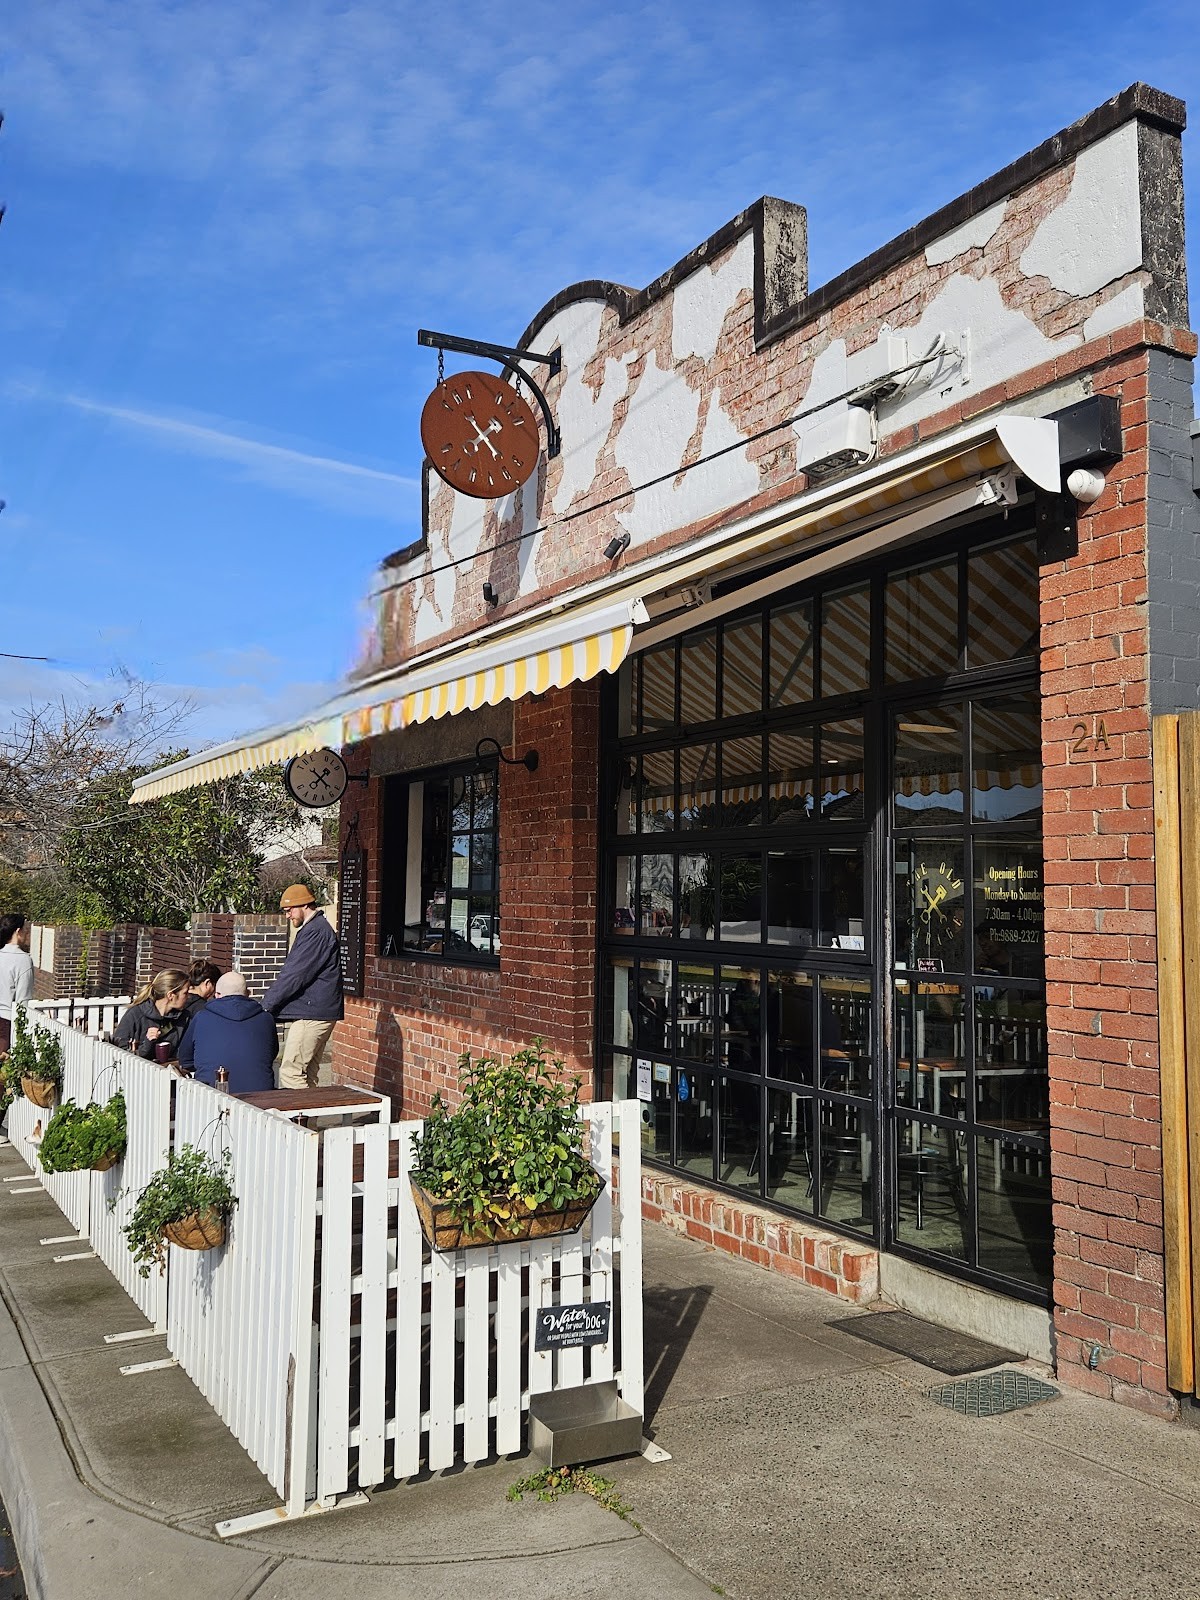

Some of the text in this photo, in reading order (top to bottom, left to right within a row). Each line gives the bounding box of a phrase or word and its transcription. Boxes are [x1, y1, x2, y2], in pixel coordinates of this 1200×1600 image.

[495, 391, 525, 426] OLD
[441, 443, 524, 486] GARAGE
[1072, 719, 1111, 753] 2A
[297, 755, 340, 771] THE OLD
[296, 784, 341, 801] GARAGE
[939, 862, 961, 889] OLD
[989, 865, 1038, 881] Opening Hours
[984, 887, 1043, 903] Monday to Sunday
[985, 907, 1011, 921] 7.30am
[1016, 907, 1043, 923] 4.00pm
[543, 1308, 589, 1331] Water
[573, 1322, 584, 1331] your
[585, 1315, 601, 1330] DOG
